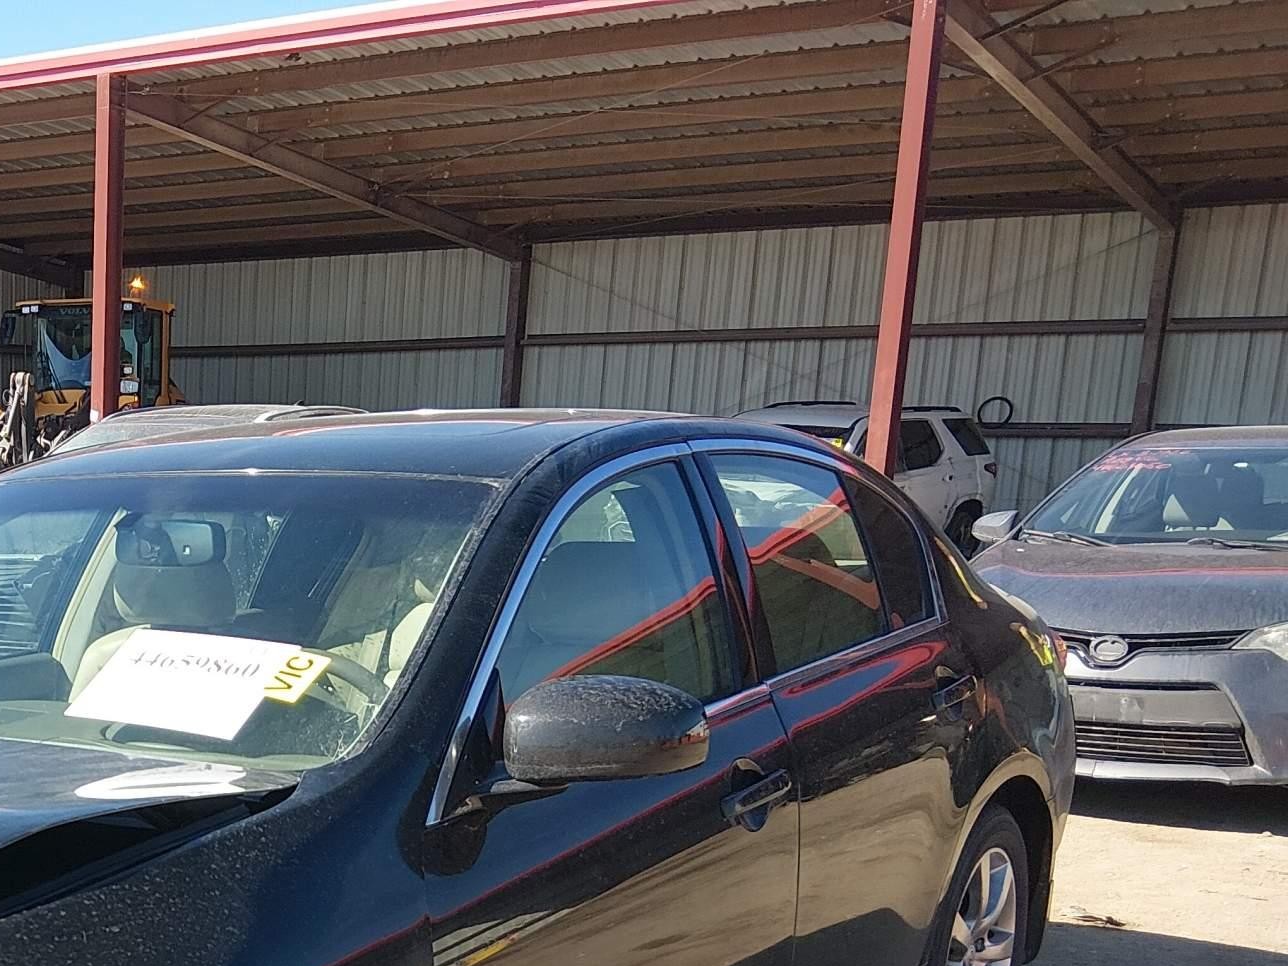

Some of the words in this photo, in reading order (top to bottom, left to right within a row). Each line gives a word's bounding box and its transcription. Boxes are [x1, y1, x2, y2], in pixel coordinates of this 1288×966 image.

[59, 306, 91, 315] VOLV
[130, 650, 261, 678] 44659860
[264, 655, 314, 692] VIC
